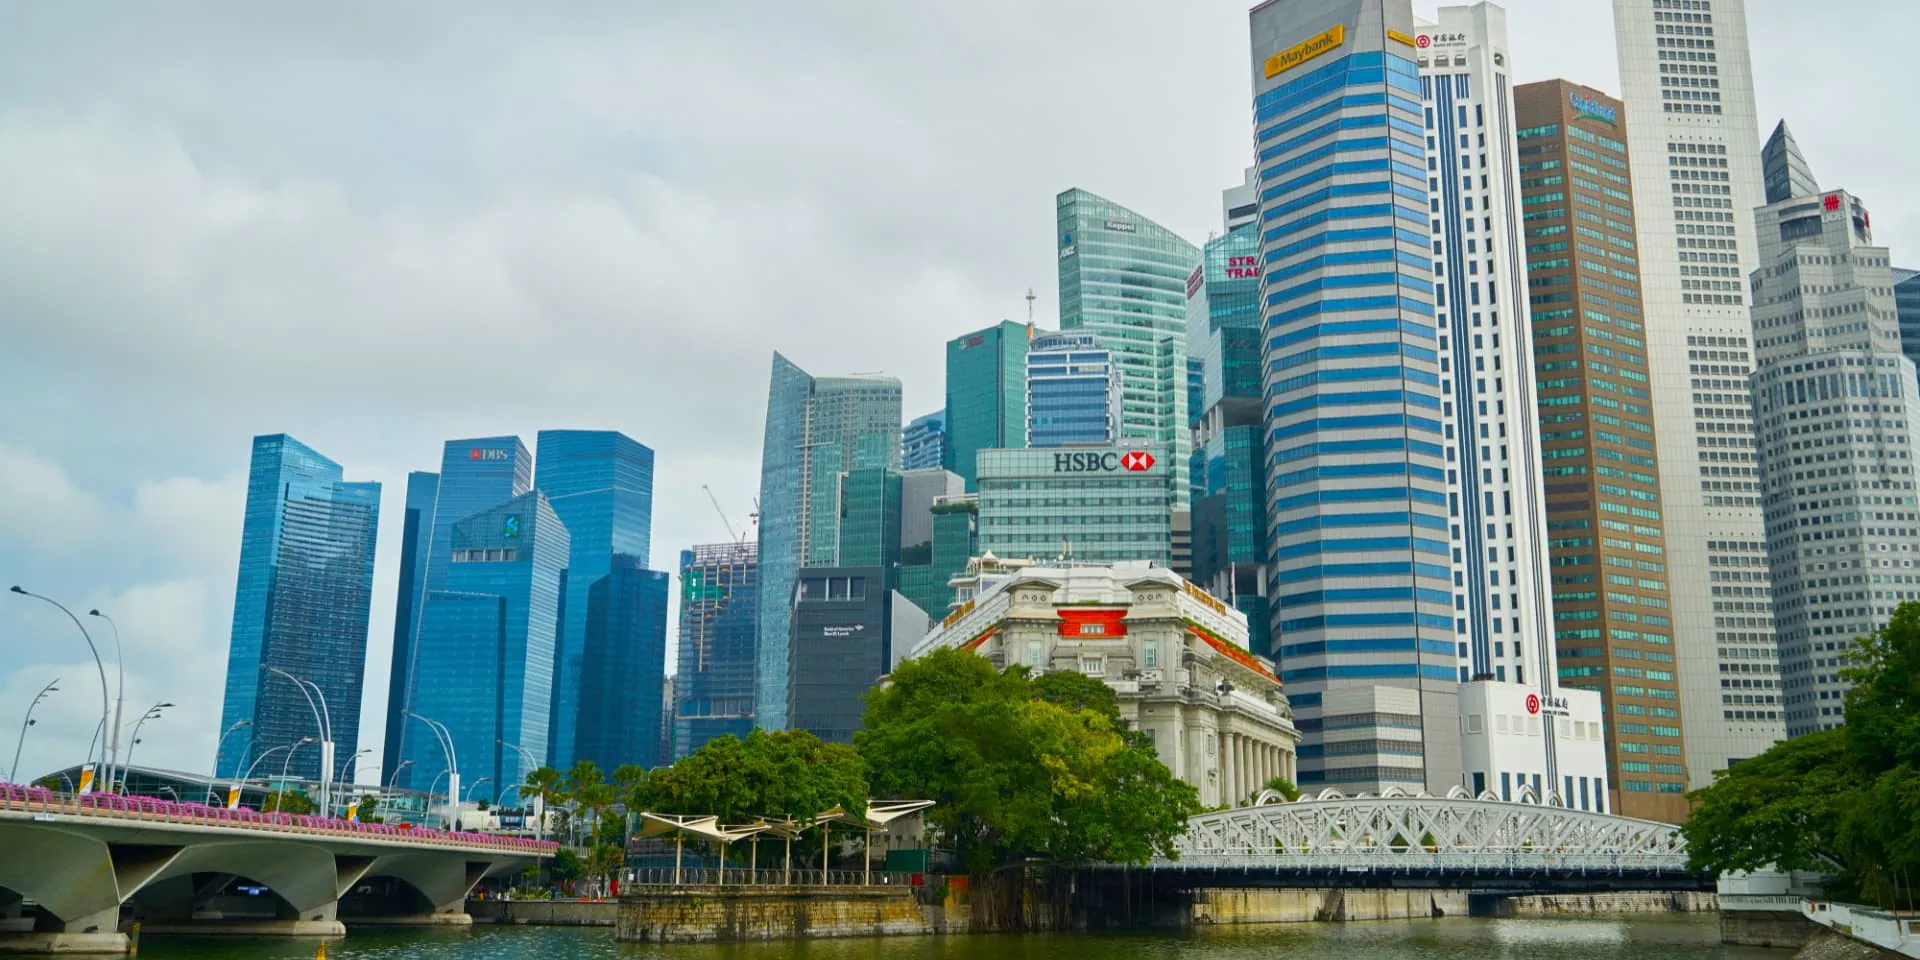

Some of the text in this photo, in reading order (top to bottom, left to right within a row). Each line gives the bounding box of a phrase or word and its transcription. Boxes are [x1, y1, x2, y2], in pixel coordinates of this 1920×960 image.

[1280, 33, 1333, 67] Maybank
[1107, 222, 1135, 232] Keppel
[482, 449, 508, 460] DBS
[1054, 452, 1118, 472] HSBC
